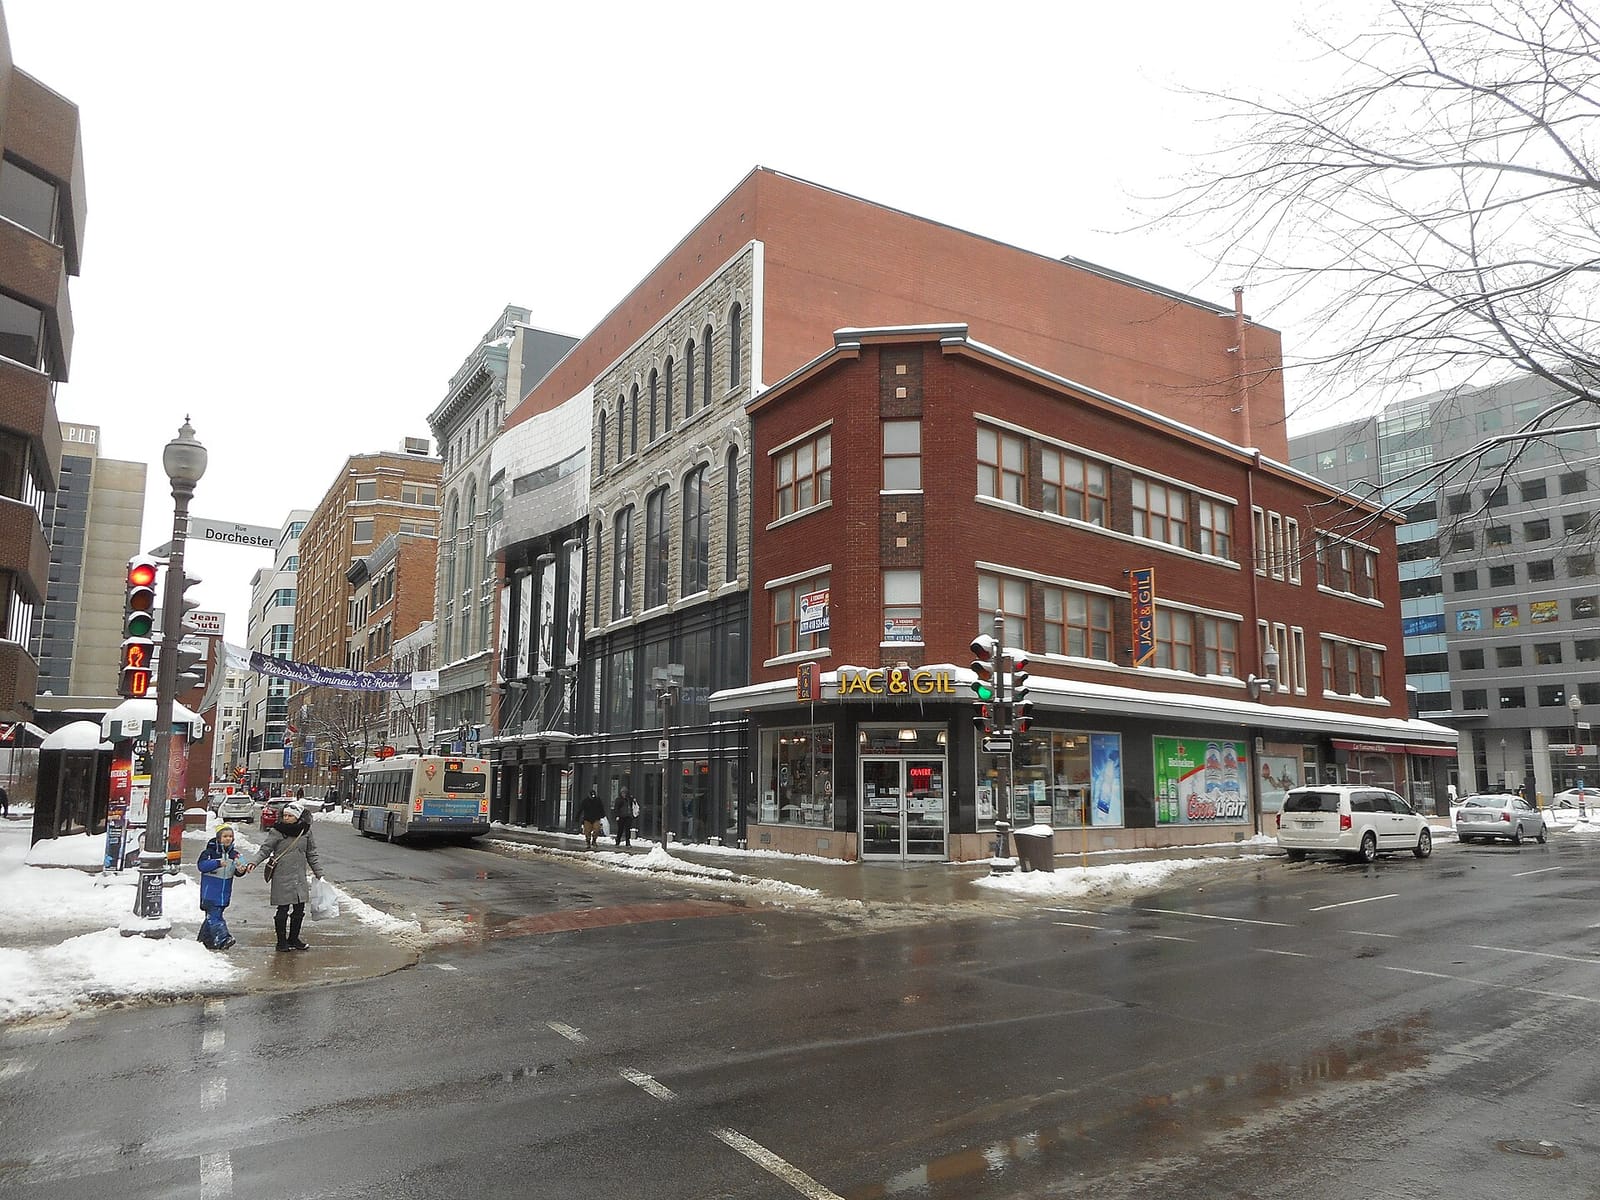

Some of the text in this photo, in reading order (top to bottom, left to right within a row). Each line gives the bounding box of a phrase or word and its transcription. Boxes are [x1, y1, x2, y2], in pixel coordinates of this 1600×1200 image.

[205, 528, 274, 547] Dorchester
[234, 524, 248, 532] Rue
[190, 613, 218, 622] Jean
[1138, 575, 1152, 647] JAC & GIL
[263, 661, 399, 689] Parcours Lumineux St-Roch
[838, 669, 955, 694] JAC & GIL
[910, 768, 931, 776] OUVERT
[1216, 797, 1246, 818] LIGHT
